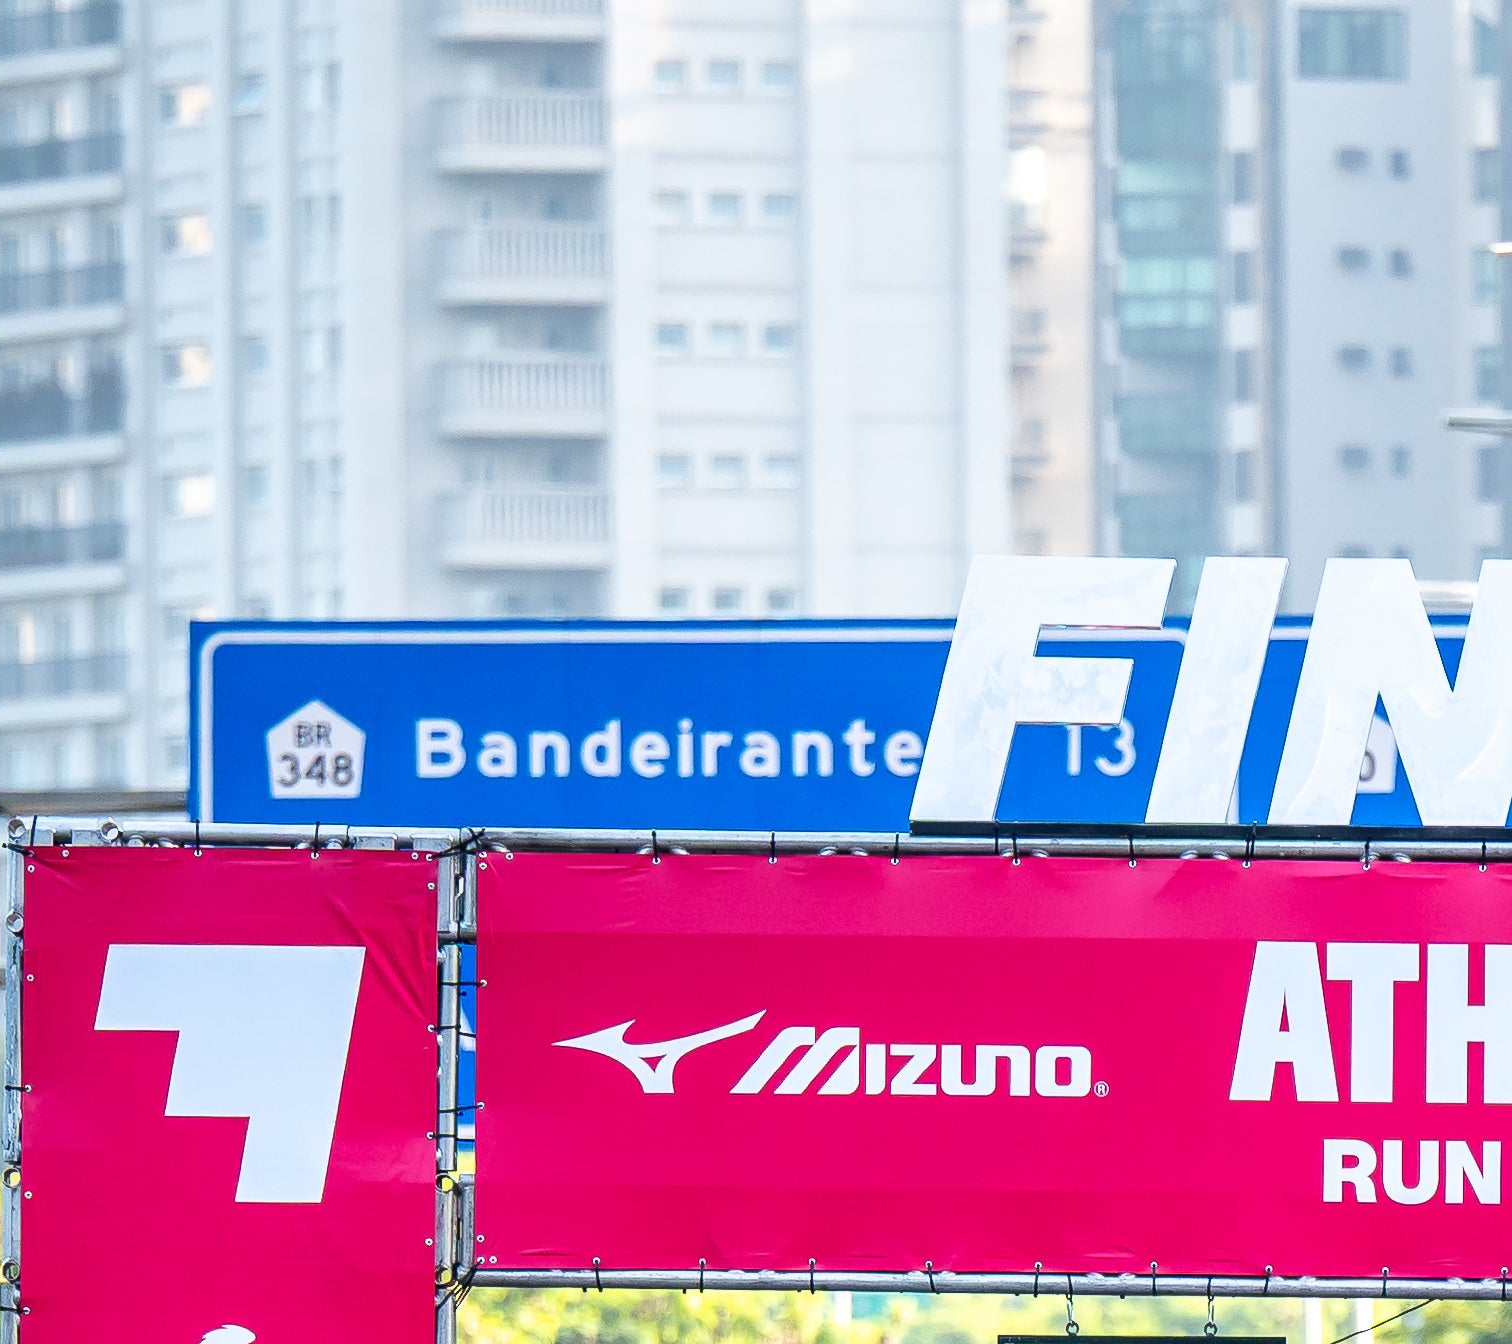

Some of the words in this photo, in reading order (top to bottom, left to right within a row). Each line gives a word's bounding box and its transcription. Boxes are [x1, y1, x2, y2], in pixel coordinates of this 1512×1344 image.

[294, 721, 332, 748] BR
[276, 752, 354, 787] 348
[1322, 1139, 1501, 1205] RUN
